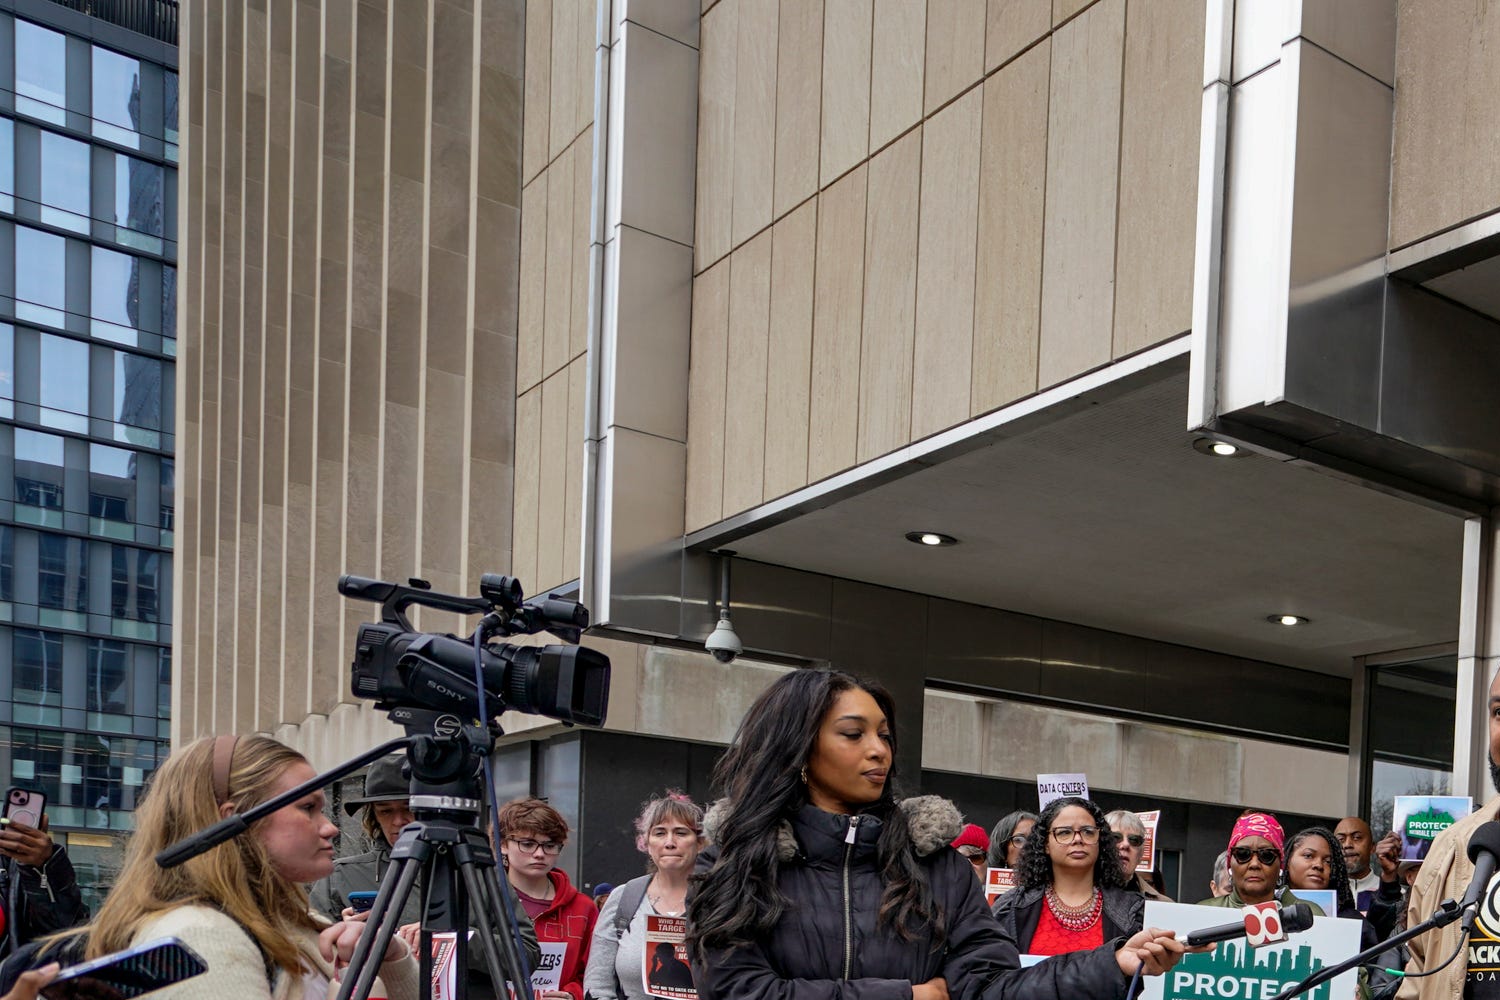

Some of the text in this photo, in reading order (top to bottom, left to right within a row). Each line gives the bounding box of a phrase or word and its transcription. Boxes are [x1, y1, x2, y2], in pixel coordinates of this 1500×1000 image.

[427, 680, 466, 701] SONY
[1039, 782, 1086, 794] DATA CENTERS
[1409, 821, 1451, 830] PROTECT
[658, 917, 674, 925] WHO
